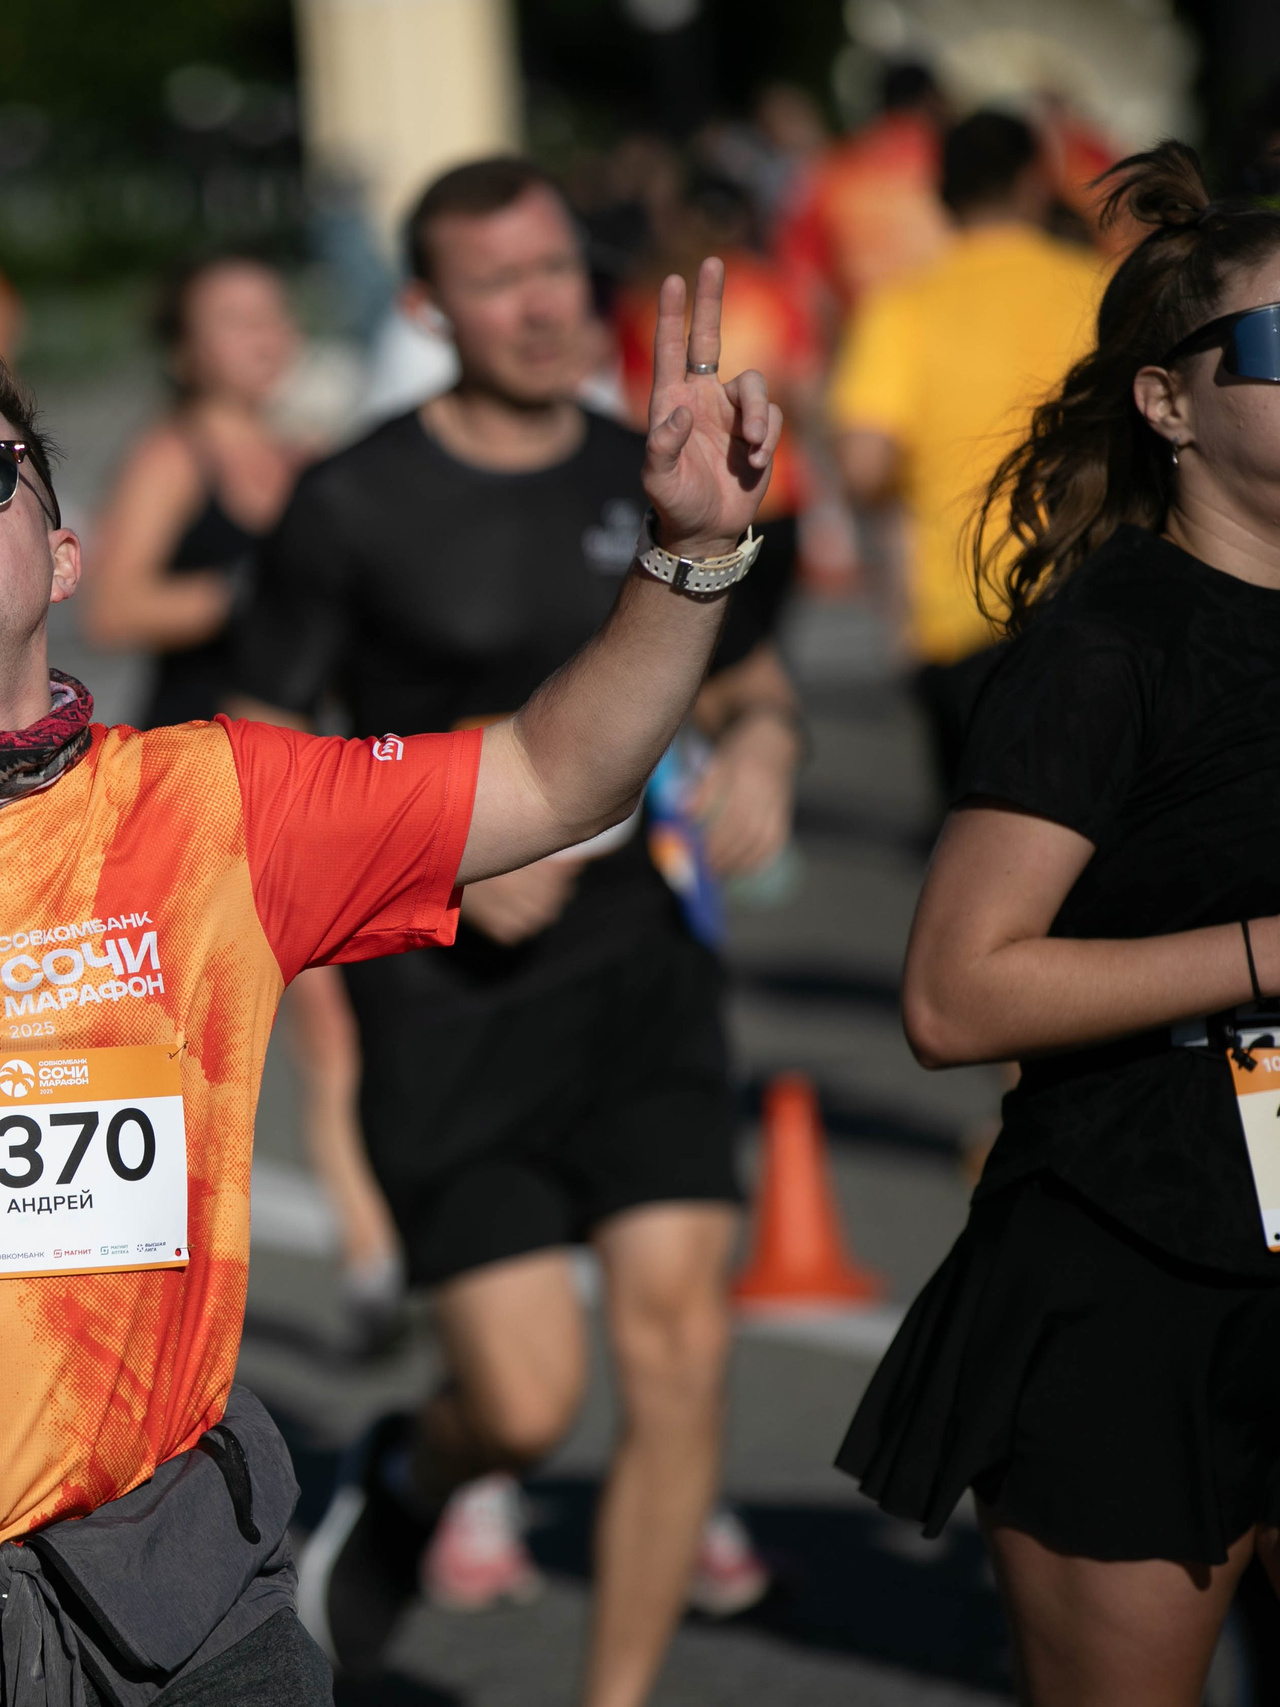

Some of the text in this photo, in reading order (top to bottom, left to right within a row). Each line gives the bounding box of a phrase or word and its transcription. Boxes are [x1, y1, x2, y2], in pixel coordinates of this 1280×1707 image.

[0, 931, 161, 992] СОЧИ
[4, 973, 165, 1018] МАРАФОН
[9, 1021, 55, 1039] 2025
[38, 1058, 88, 1067] СОВКОМБАНК
[38, 1066, 89, 1080] СОЧИ
[39, 1078, 89, 1087] МАРАФОН
[7, 1189, 94, 1215] АНДРЕЙ
